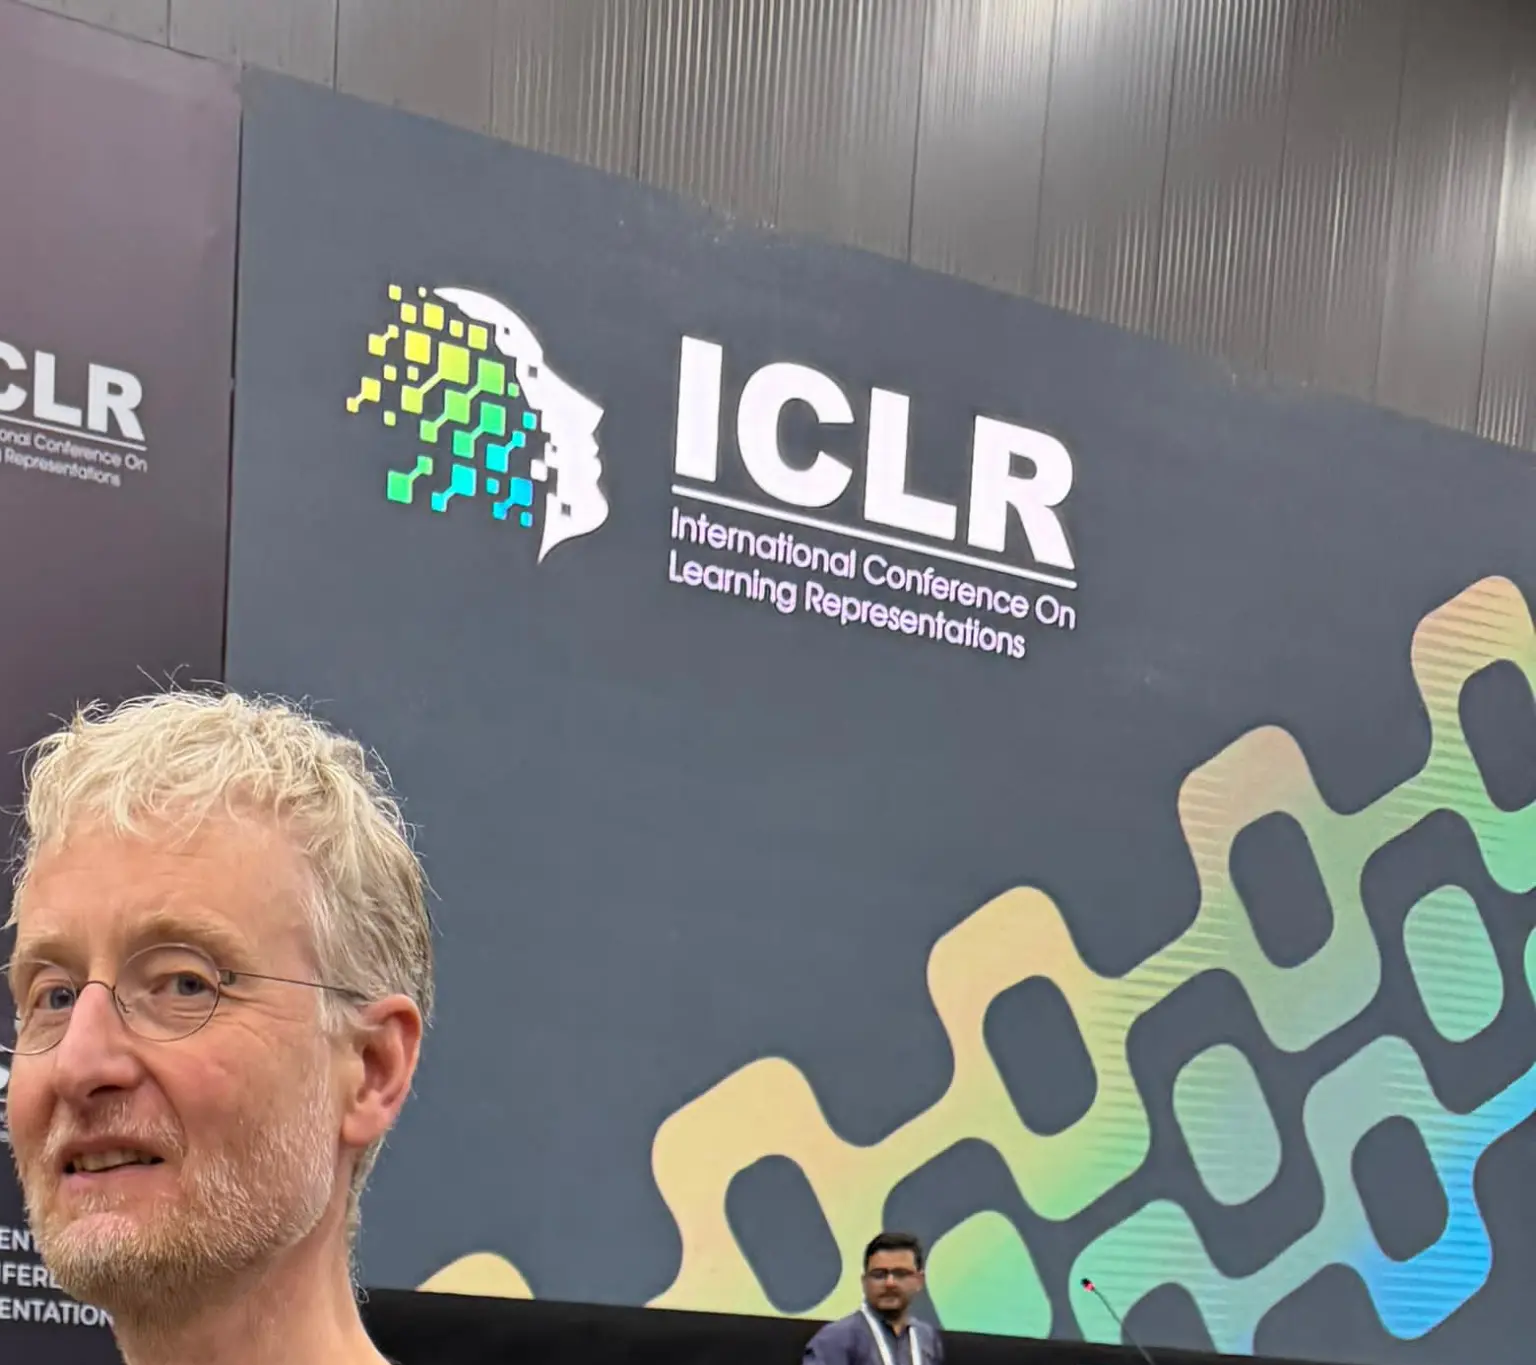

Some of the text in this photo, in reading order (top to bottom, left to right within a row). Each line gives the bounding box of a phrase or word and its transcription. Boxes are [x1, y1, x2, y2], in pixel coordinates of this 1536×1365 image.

[4, 446, 121, 488] Representations
[33, 433, 122, 469] Conference
[124, 453, 148, 473] On
[675, 335, 1075, 570] ICLR
[669, 551, 1026, 659] Learning Representations
[671, 507, 1077, 630] International Conference On
